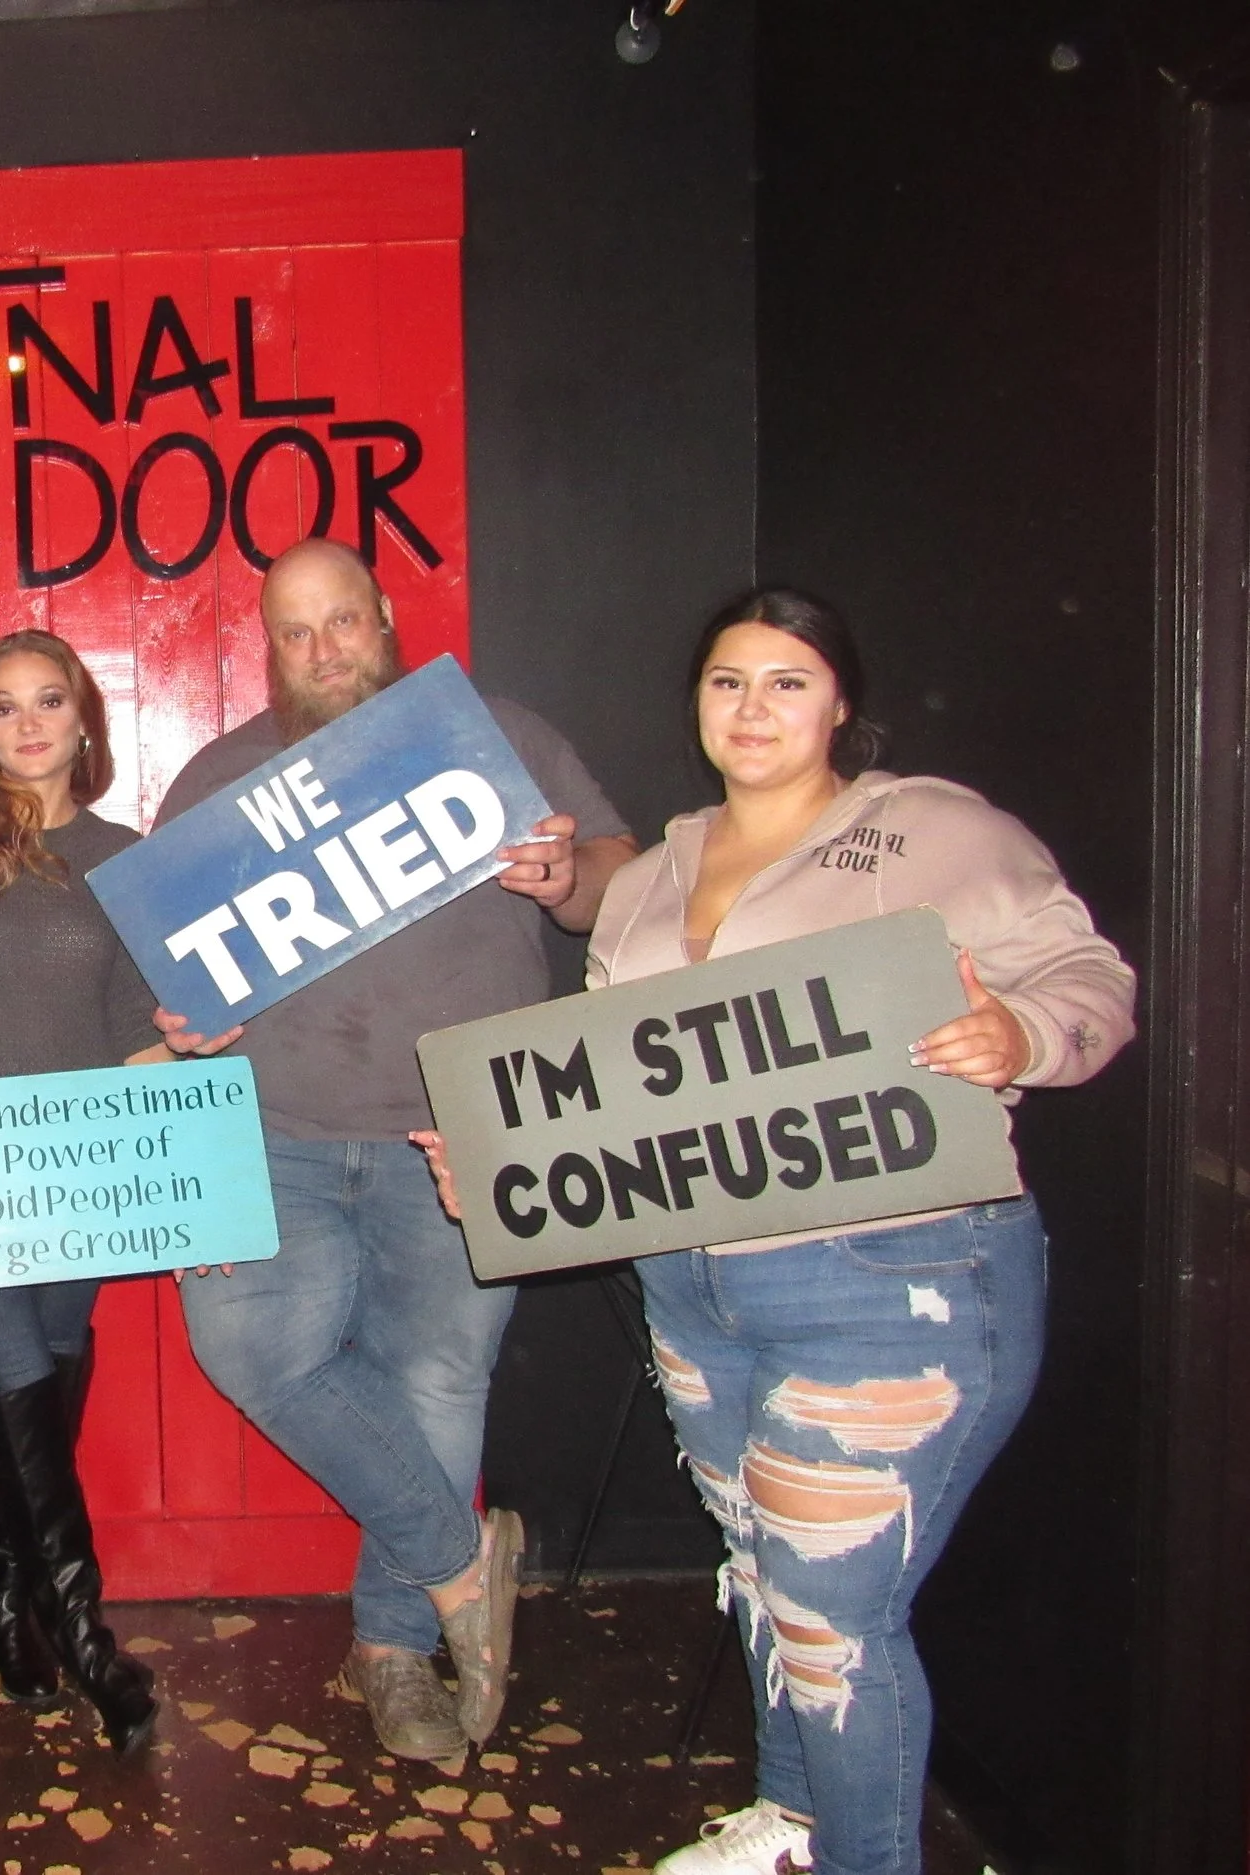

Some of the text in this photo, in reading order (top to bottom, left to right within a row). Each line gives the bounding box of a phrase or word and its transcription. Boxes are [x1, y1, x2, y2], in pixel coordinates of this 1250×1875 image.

[13, 419, 445, 590] DOOR
[236, 757, 342, 854] WE
[164, 769, 506, 1006] TRIED
[820, 849, 878, 873] LOVE
[488, 976, 872, 1130] I'M STILL
[4, 1139, 126, 1174] Power
[135, 1125, 174, 1160] of
[47, 1175, 163, 1218] People
[171, 1171, 203, 1201] in
[493, 1086, 937, 1239] CONFUSED
[60, 1222, 191, 1260] Groups
